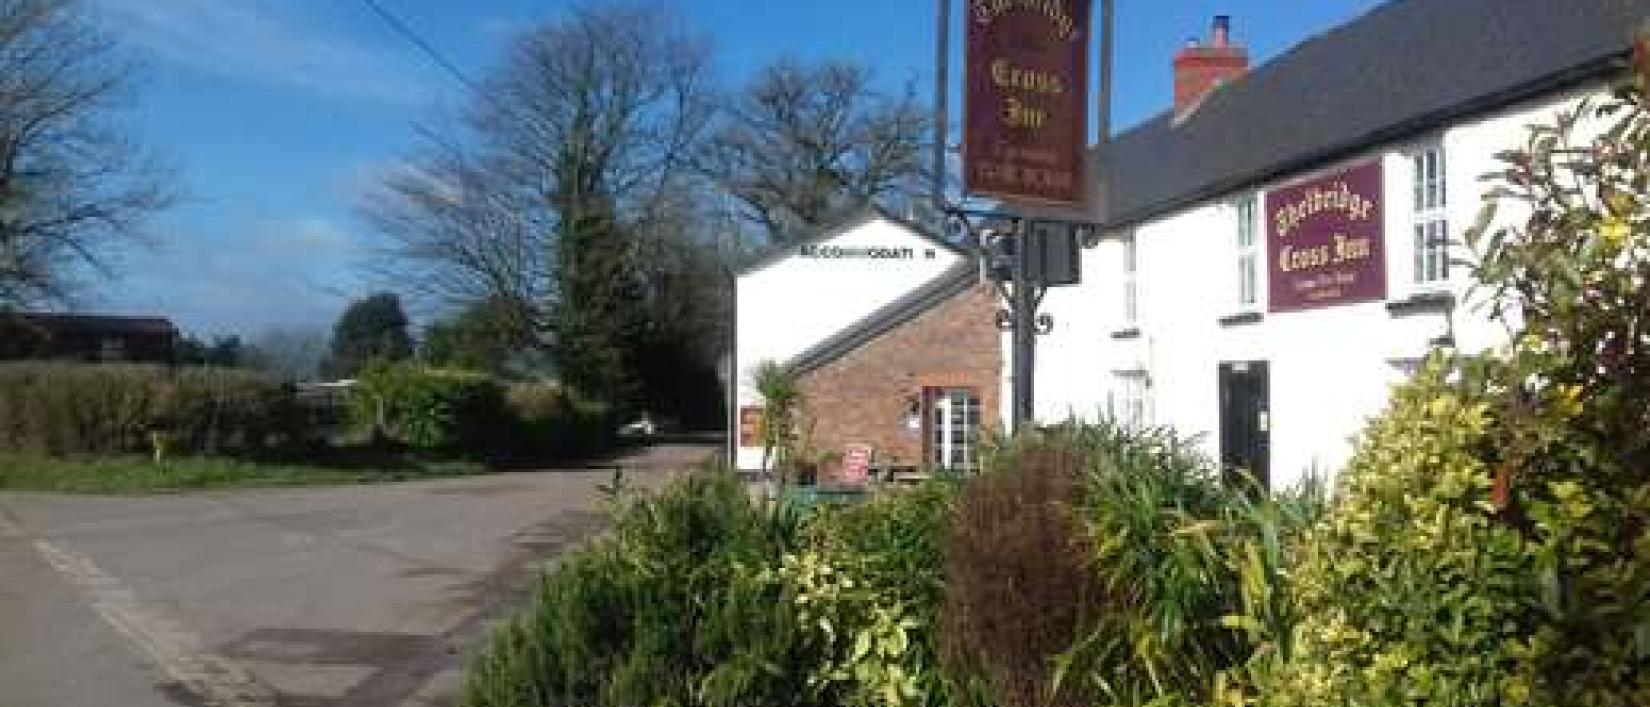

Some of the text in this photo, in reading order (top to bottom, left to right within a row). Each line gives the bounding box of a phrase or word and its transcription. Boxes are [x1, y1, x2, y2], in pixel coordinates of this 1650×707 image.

[992, 59, 1064, 92] Cross
[800, 245, 936, 259] ACCOODATIN
[1279, 233, 1370, 272] Cross Inn
